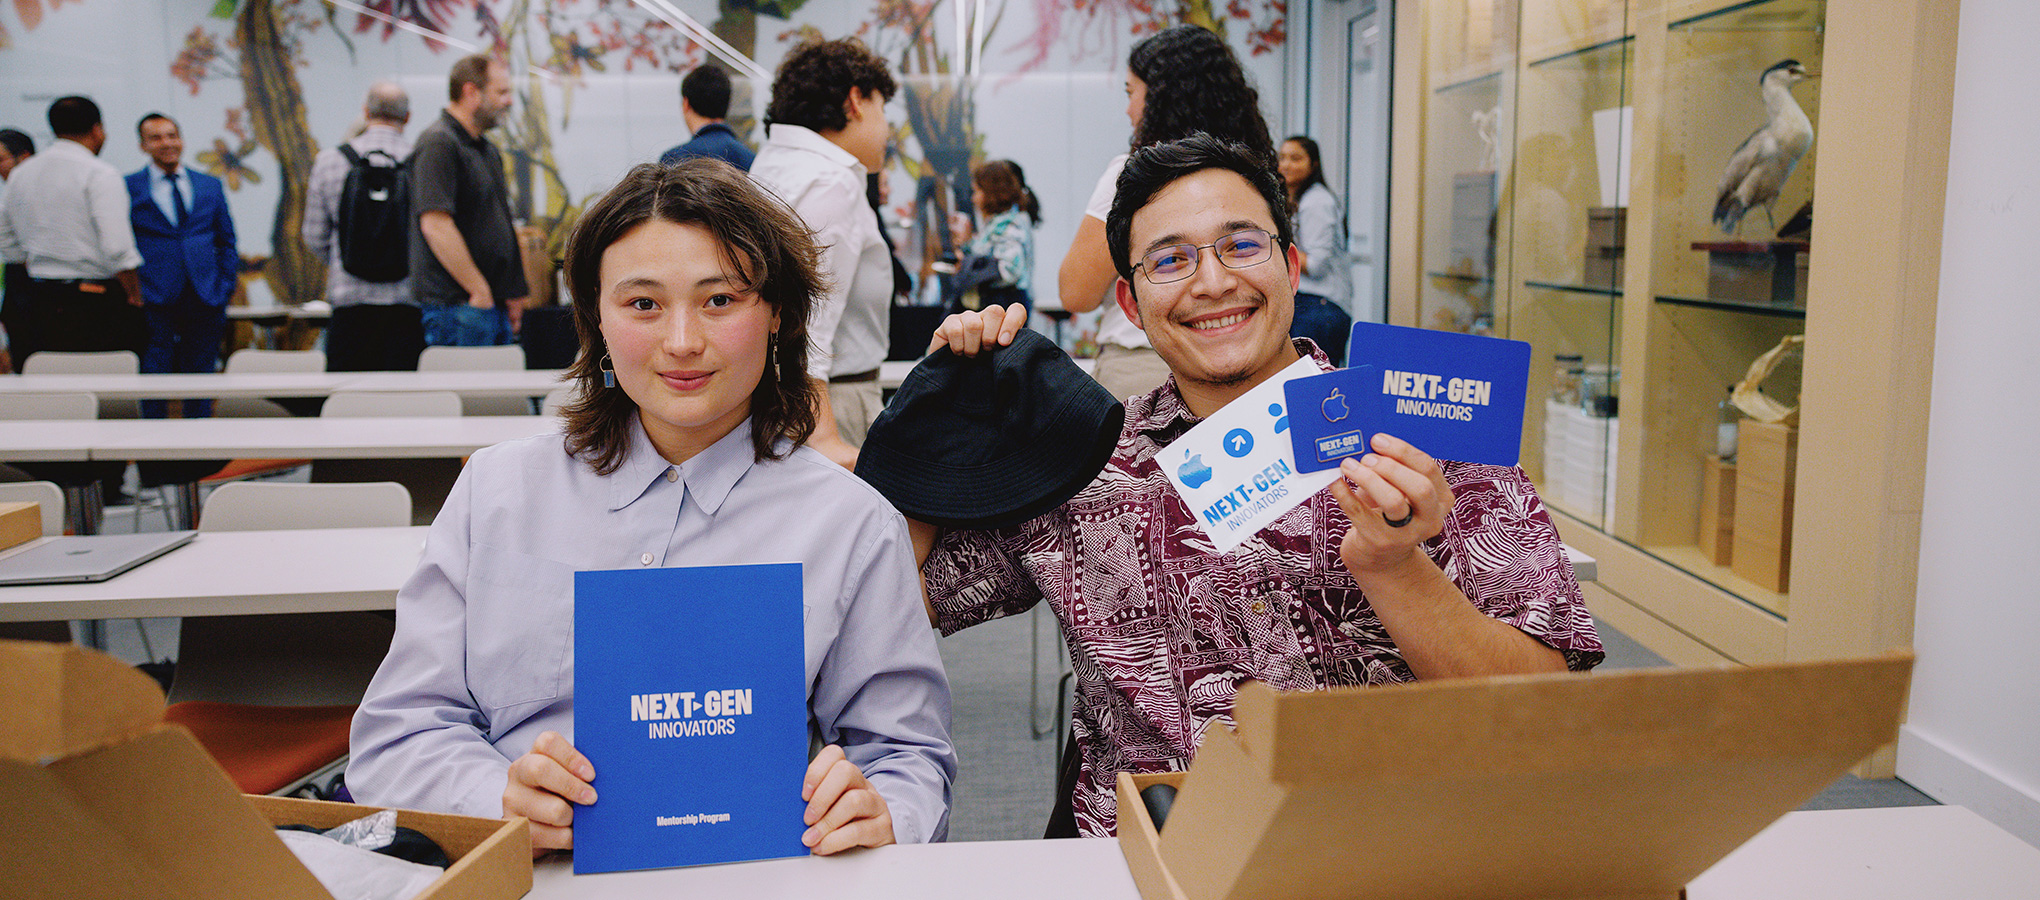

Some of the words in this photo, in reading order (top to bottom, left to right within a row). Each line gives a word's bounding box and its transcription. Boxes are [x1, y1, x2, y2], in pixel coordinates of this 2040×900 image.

[1396, 398, 1473, 421] INNOVATORS
[1226, 484, 1289, 531] INNOVATORS
[648, 718, 736, 739] INNOVATORS
[656, 814, 698, 826] Mentorship
[699, 813, 731, 824] Program
